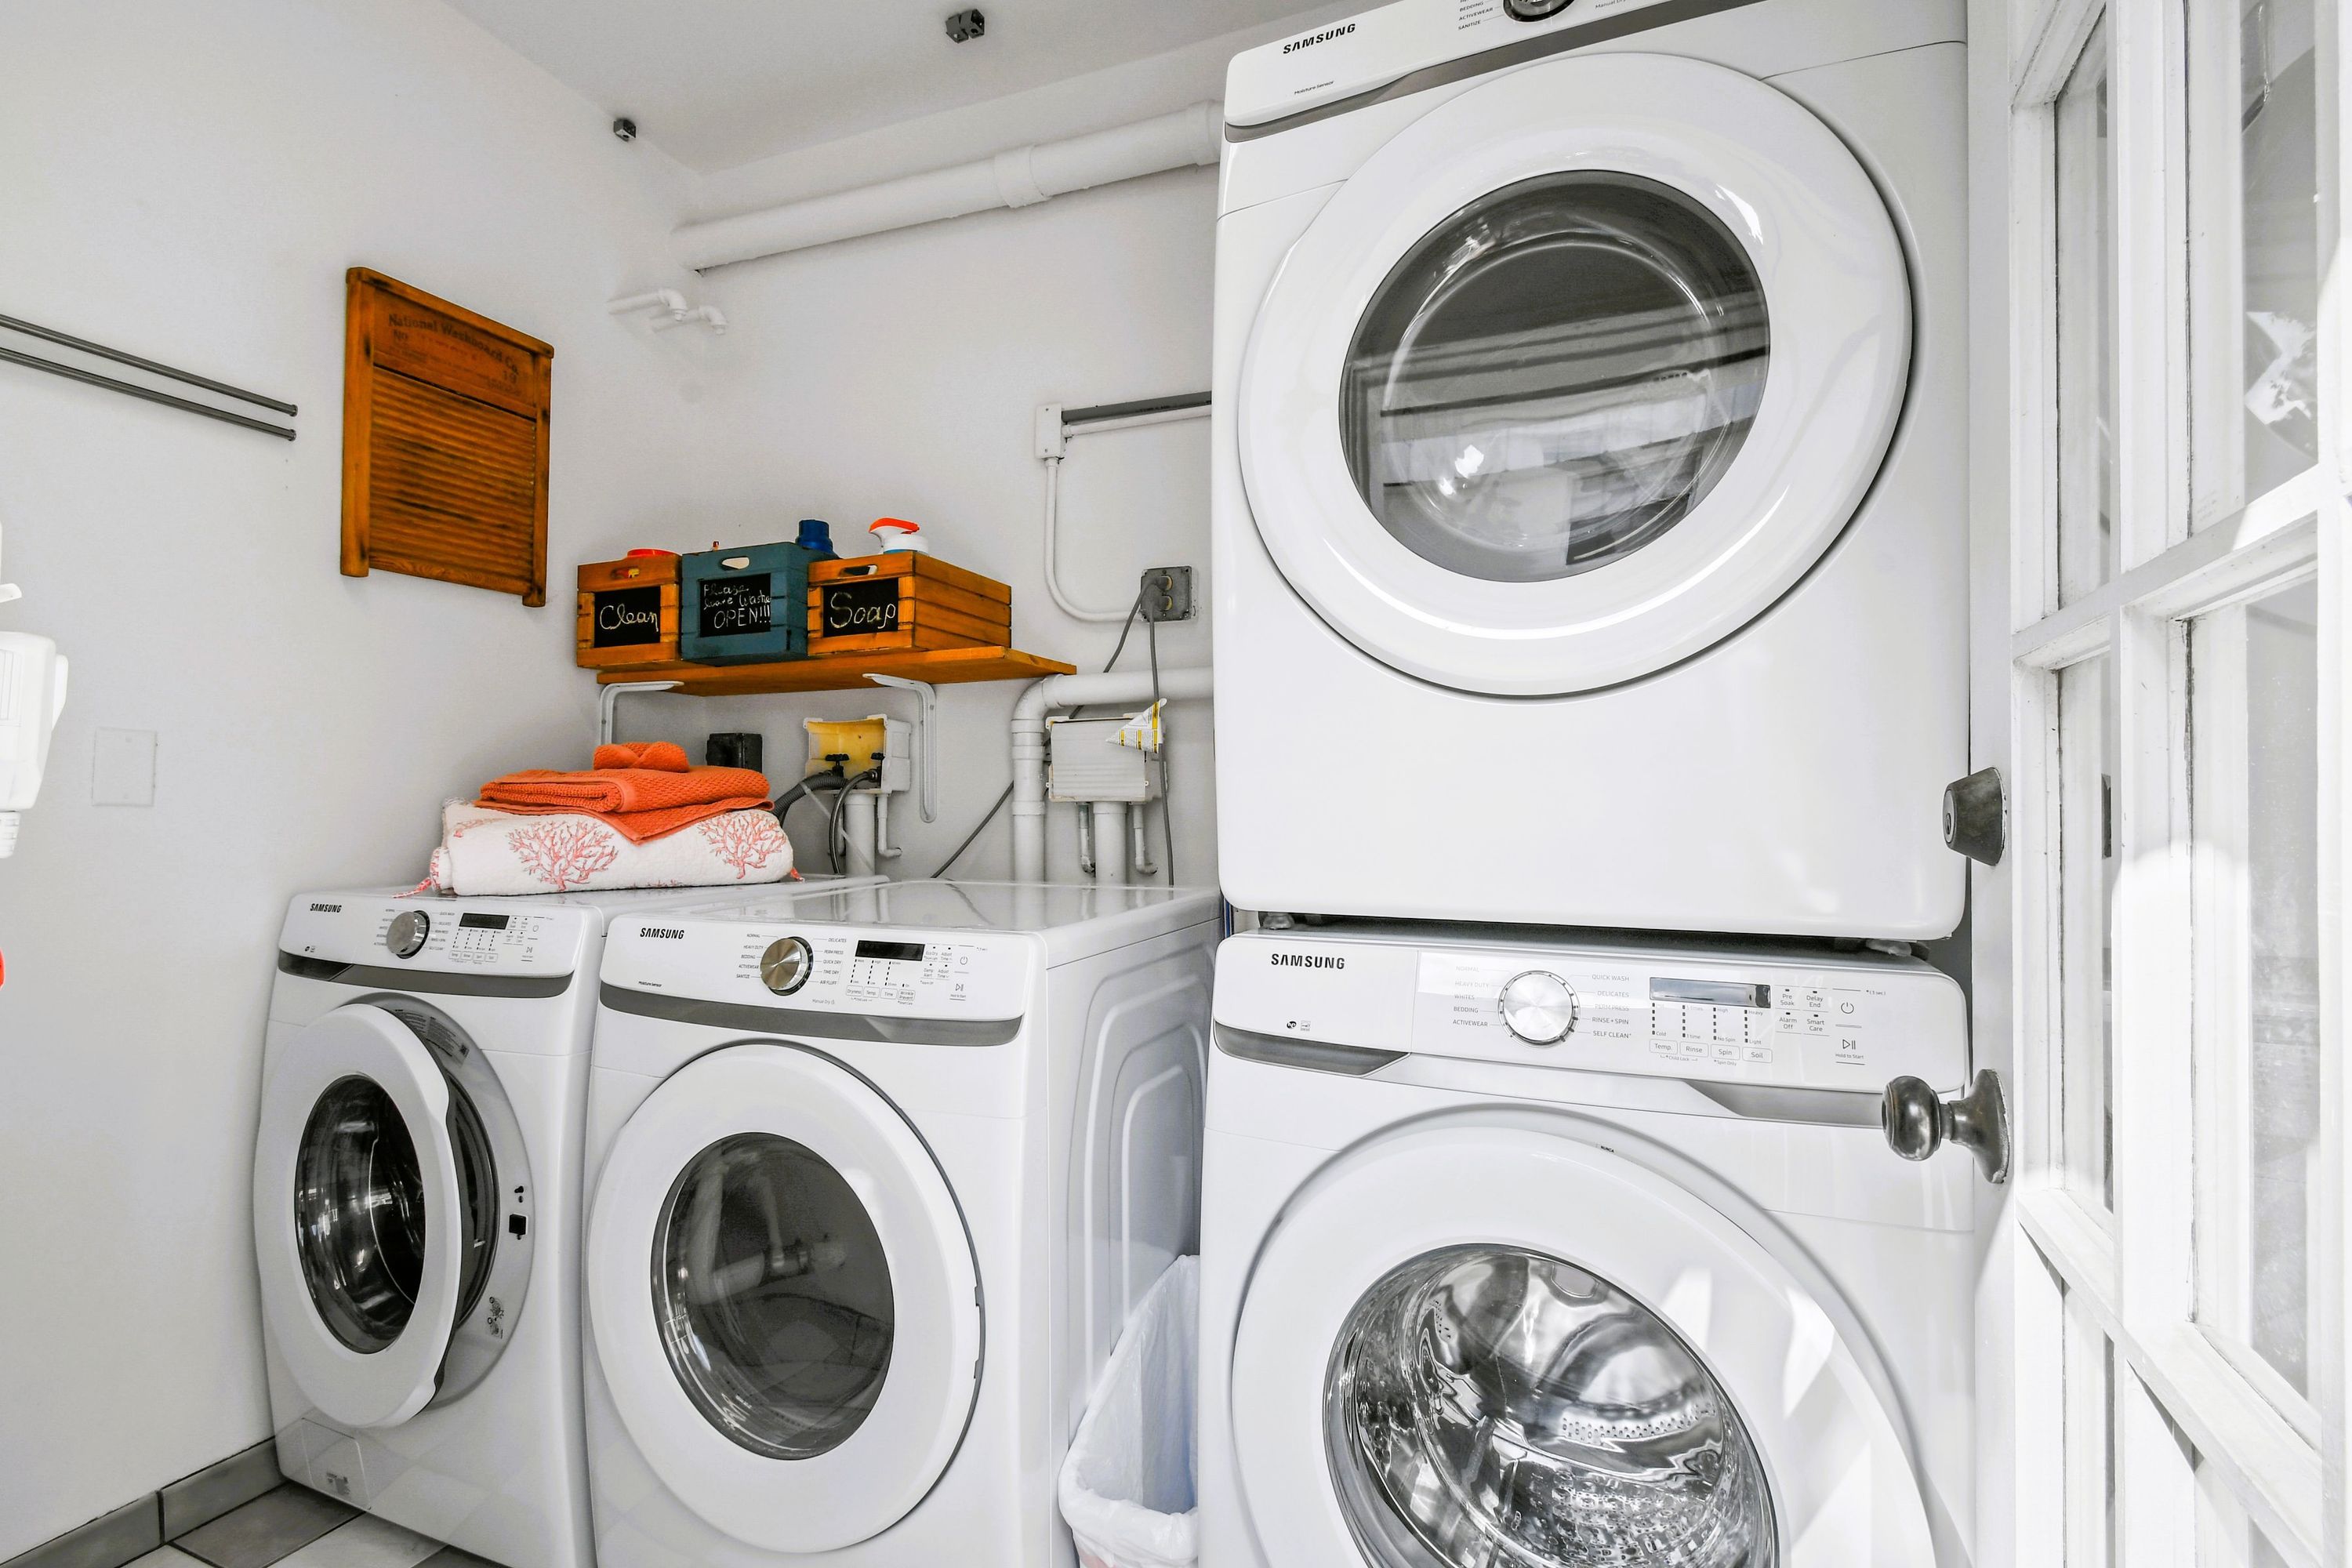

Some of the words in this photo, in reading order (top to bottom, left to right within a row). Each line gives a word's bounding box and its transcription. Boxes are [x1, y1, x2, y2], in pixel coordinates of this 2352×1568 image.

[1458, 7, 1494, 21] ACTIVEWEAR
[1459, 1, 1484, 13] BEDDING
[1457, 20, 1482, 31] SANITIZE
[1283, 23, 1356, 55] SAMSUNG
[389, 314, 438, 333] National
[441, 322, 503, 361] Washboard
[600, 603, 659, 633] Clean
[713, 604, 771, 629] OPEN!!!
[830, 591, 896, 630] Soap
[310, 903, 343, 913] SAMSUNG
[640, 927, 685, 940] SAMSUNG
[1271, 953, 1345, 970] SAMSUNG
